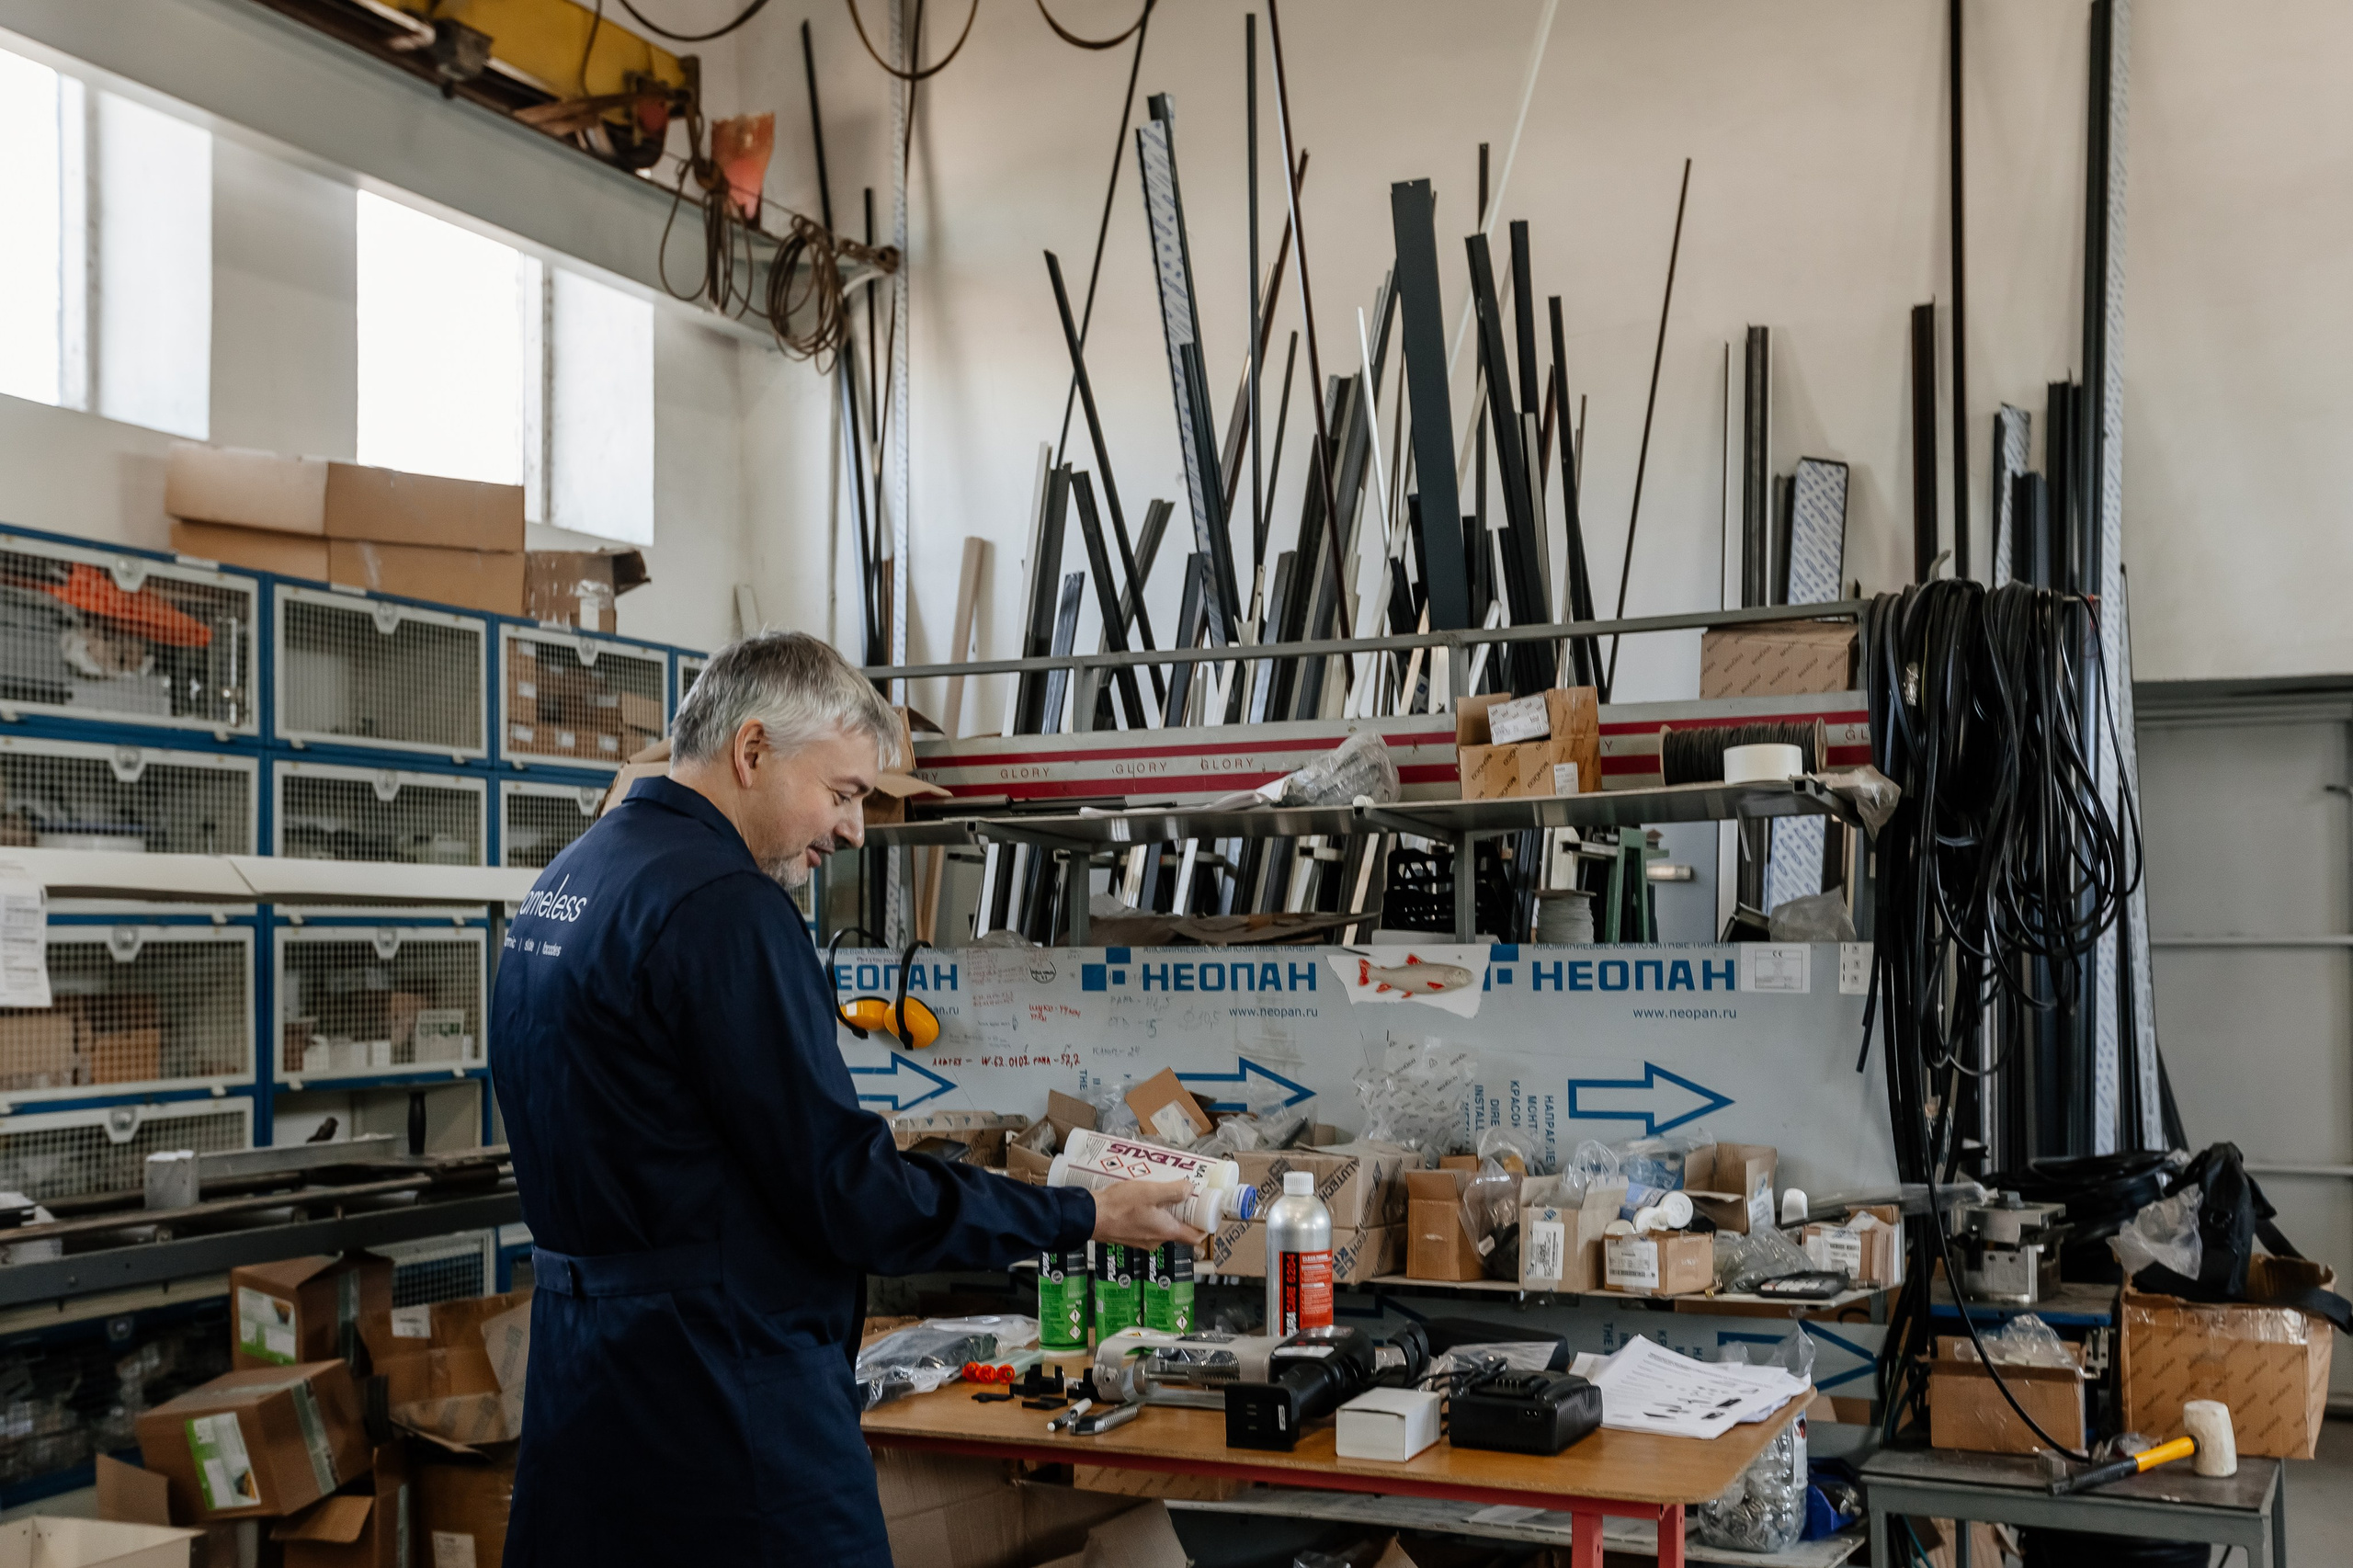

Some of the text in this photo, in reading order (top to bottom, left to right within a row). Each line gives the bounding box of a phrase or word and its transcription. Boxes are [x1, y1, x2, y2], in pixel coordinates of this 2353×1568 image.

[1000, 767, 1050, 779] GLORY
[1115, 761, 1167, 775] GLORY
[1200, 757, 1254, 771] GLORY
[519, 872, 588, 923] ameless
[836, 963, 958, 992] ЕОПАН
[1142, 962, 1316, 992] НЕОПАН
[1532, 960, 1735, 992] НЕОПАН
[1228, 1006, 1318, 1020] www.neopan.ru
[1632, 1007, 1737, 1021] www.neopan.ru
[1079, 1069, 1088, 1091] THE
[1106, 1143, 1197, 1171] PLEXUS
[1223, 1220, 1253, 1247] TECH
[1286, 1254, 1297, 1283] 6204
